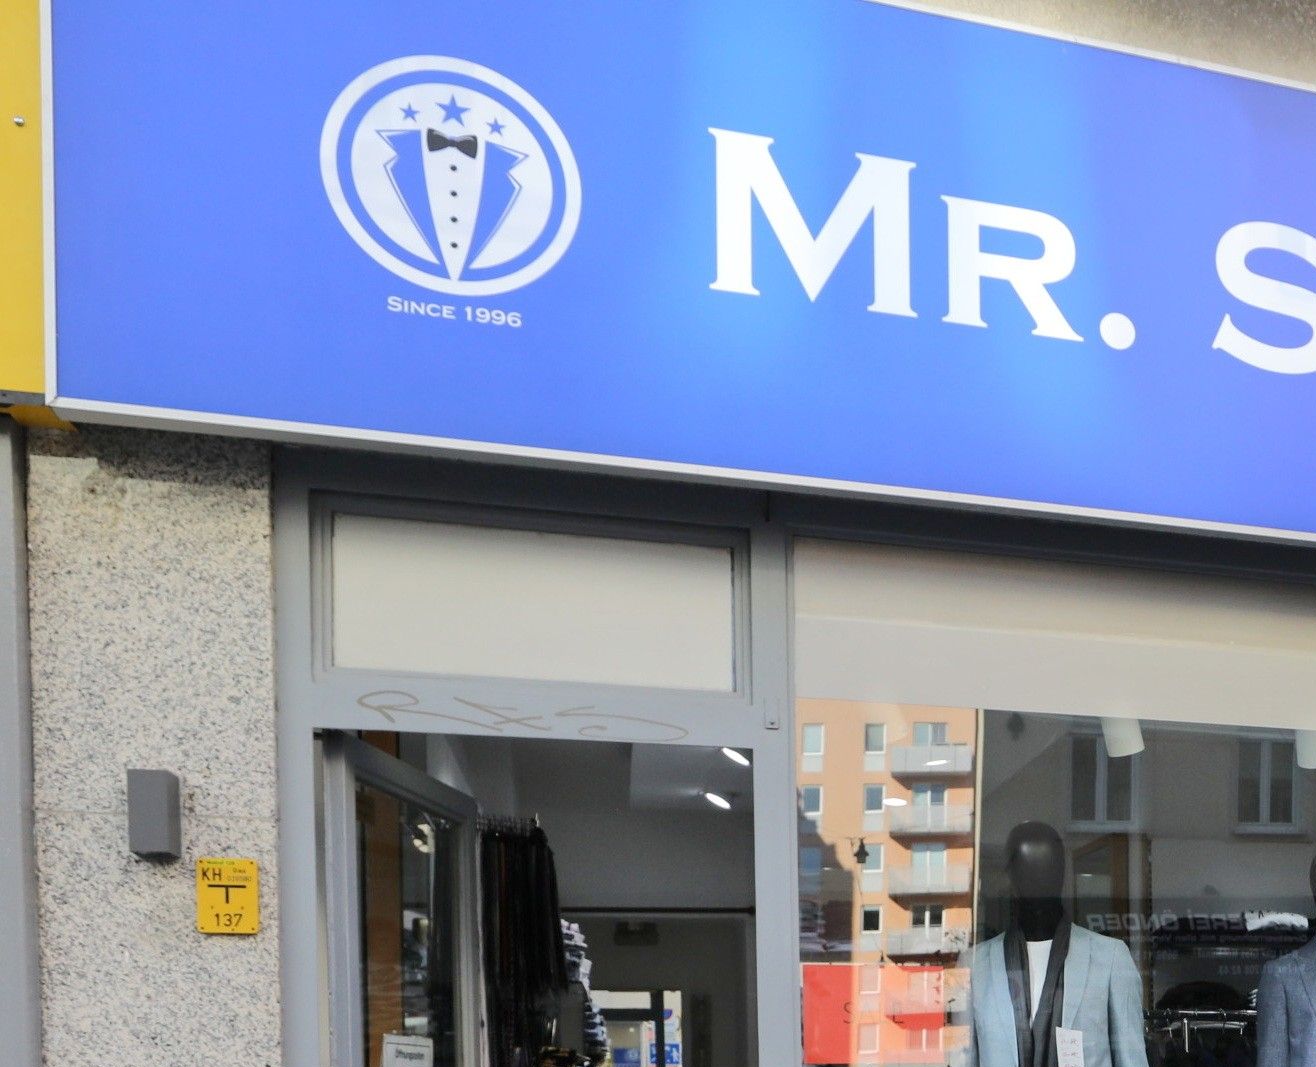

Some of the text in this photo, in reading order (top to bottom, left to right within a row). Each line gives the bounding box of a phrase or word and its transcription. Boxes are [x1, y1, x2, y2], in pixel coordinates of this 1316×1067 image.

[464, 305, 523, 328] 1996
[201, 867, 222, 881] KH
[214, 913, 243, 927] 137
